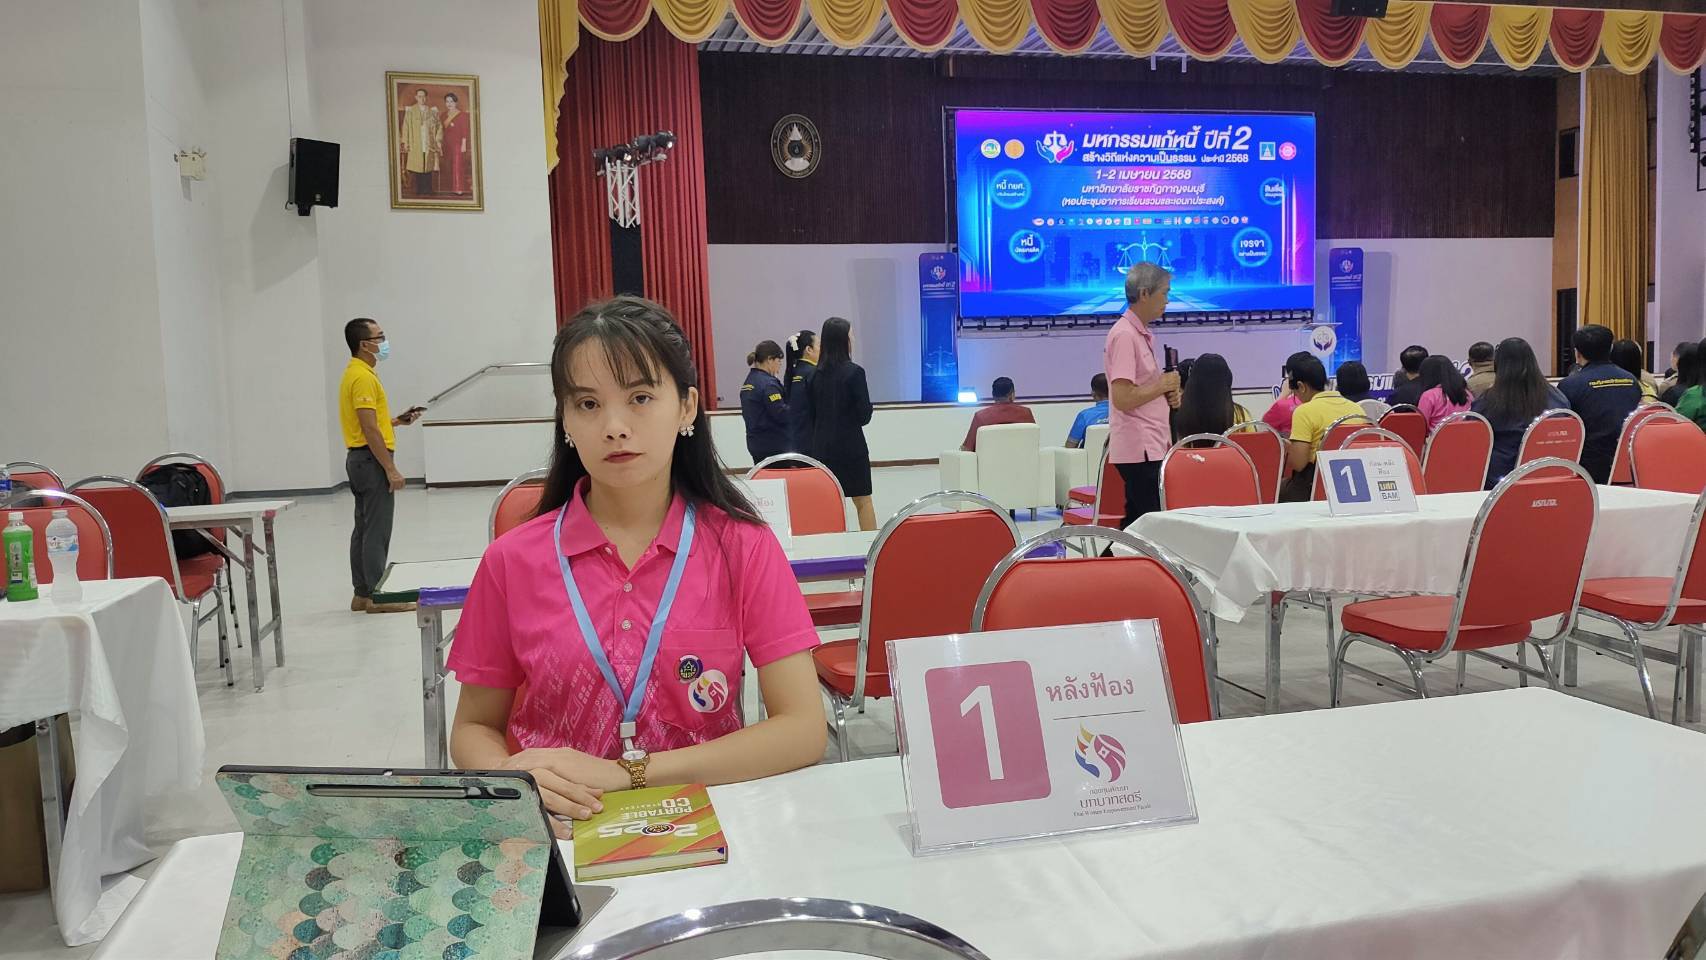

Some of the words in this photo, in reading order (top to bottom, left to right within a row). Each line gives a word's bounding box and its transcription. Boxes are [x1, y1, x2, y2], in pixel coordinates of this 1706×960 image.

[1082, 126, 1202, 149] มหกรรมแก้หนี้
[1203, 125, 1232, 149] ปีที่
[1231, 126, 1252, 150] 2
[1226, 154, 1249, 163] 2568
[1096, 169, 1116, 180] 1-2
[1119, 170, 1161, 180] เมษายน
[1163, 169, 1192, 180] 2568
[1081, 183, 1206, 195] มหาวิทยาลัยราชภัฏกาญจนบุรี
[1021, 234, 1034, 246] หนี้
[1240, 239, 1265, 248] เจรจา
[1340, 465, 1358, 496] 1
[1381, 491, 1398, 500] BAM
[1045, 671, 1135, 703] หลังฟ้อง
[959, 685, 1005, 781] 1
[1079, 790, 1142, 809] บทบาทสตรี
[621, 806, 693, 820] PORTABLE
